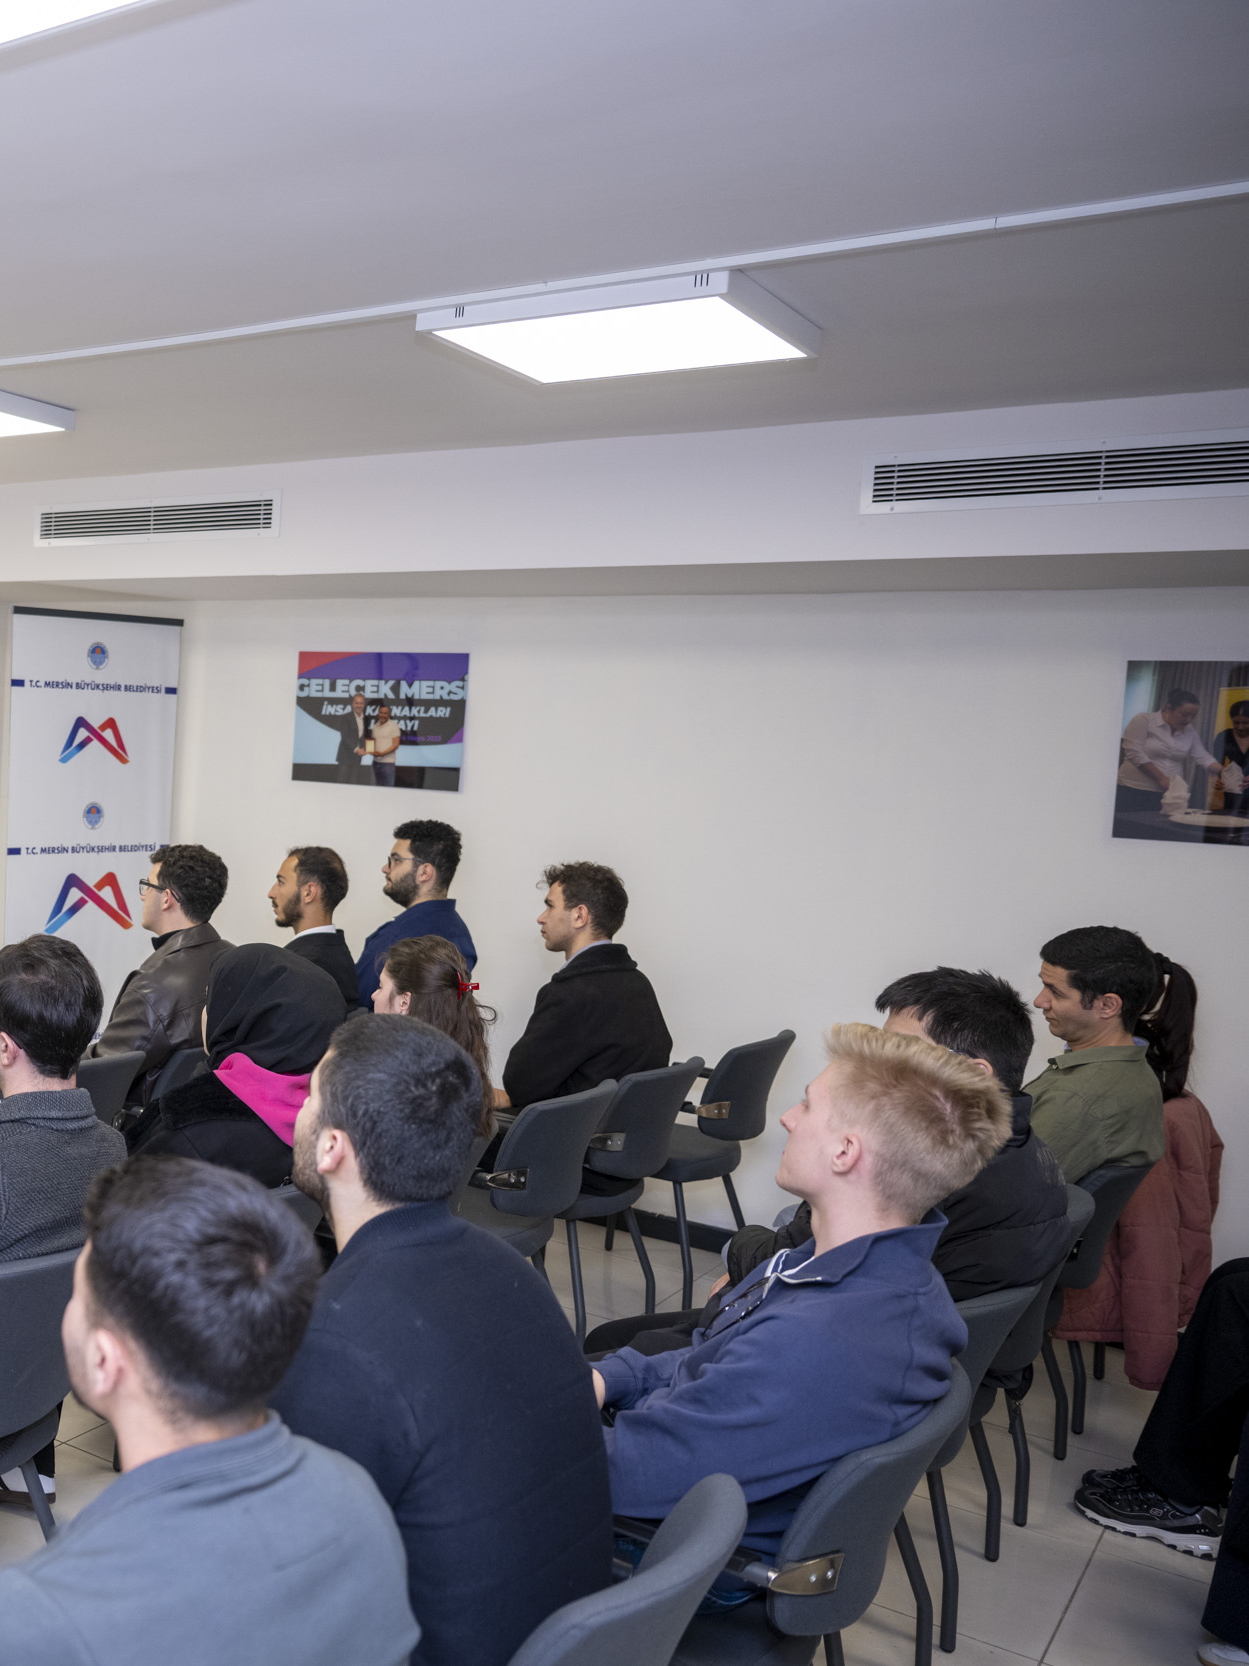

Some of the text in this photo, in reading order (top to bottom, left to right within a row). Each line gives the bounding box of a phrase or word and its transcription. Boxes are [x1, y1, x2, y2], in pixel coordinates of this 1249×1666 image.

[29, 680, 162, 694] T.C. MERSİN BÜYÜKŞEHİR BELEDİYESİ
[297, 678, 396, 699] GELECEK
[321, 701, 352, 715] İNSA
[25, 842, 156, 855] T.C. MERSİN BÜYÜKŞEHİR BELEDİYESİ
